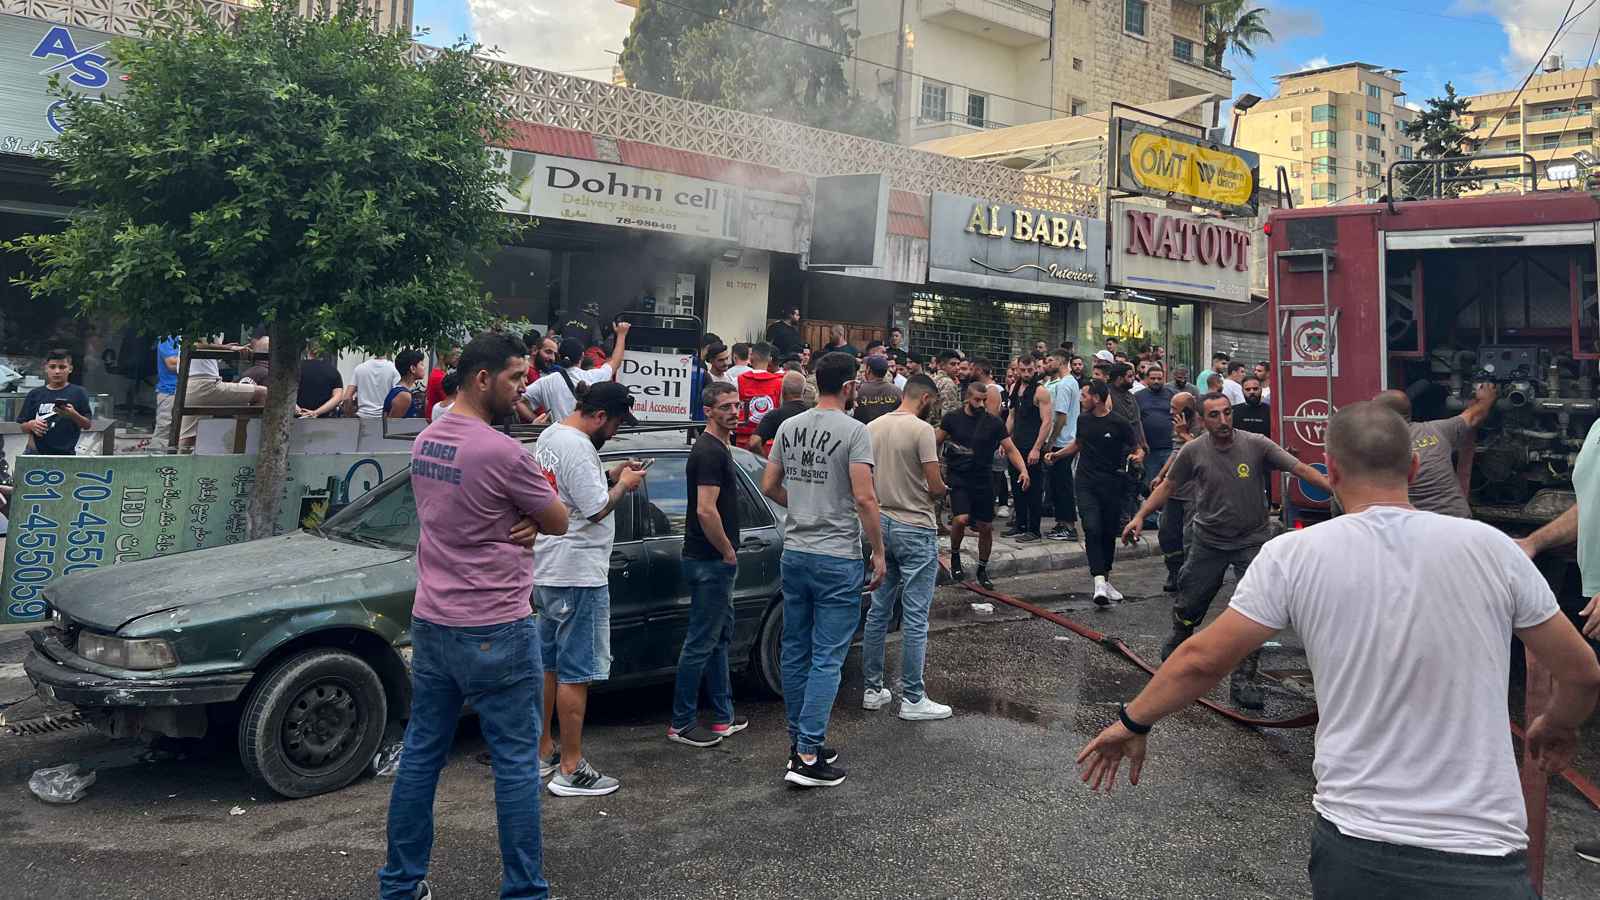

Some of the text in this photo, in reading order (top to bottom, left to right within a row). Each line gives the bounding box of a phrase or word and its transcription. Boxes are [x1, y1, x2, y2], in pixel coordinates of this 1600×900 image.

[1140, 147, 1187, 179] OMT
[562, 192, 616, 213] Delivery
[674, 187, 719, 211] cell
[965, 203, 1088, 250] AL BABA
[1126, 209, 1250, 272] NATOUT
[623, 358, 687, 378] Dohni
[627, 380, 681, 398] cell
[649, 401, 687, 415] Accessories
[420, 440, 458, 461] FADED
[782, 427, 842, 456] AMIRI
[412, 458, 464, 486] CULTURE
[120, 486, 149, 528] LED
[8, 470, 65, 619] 81-455059
